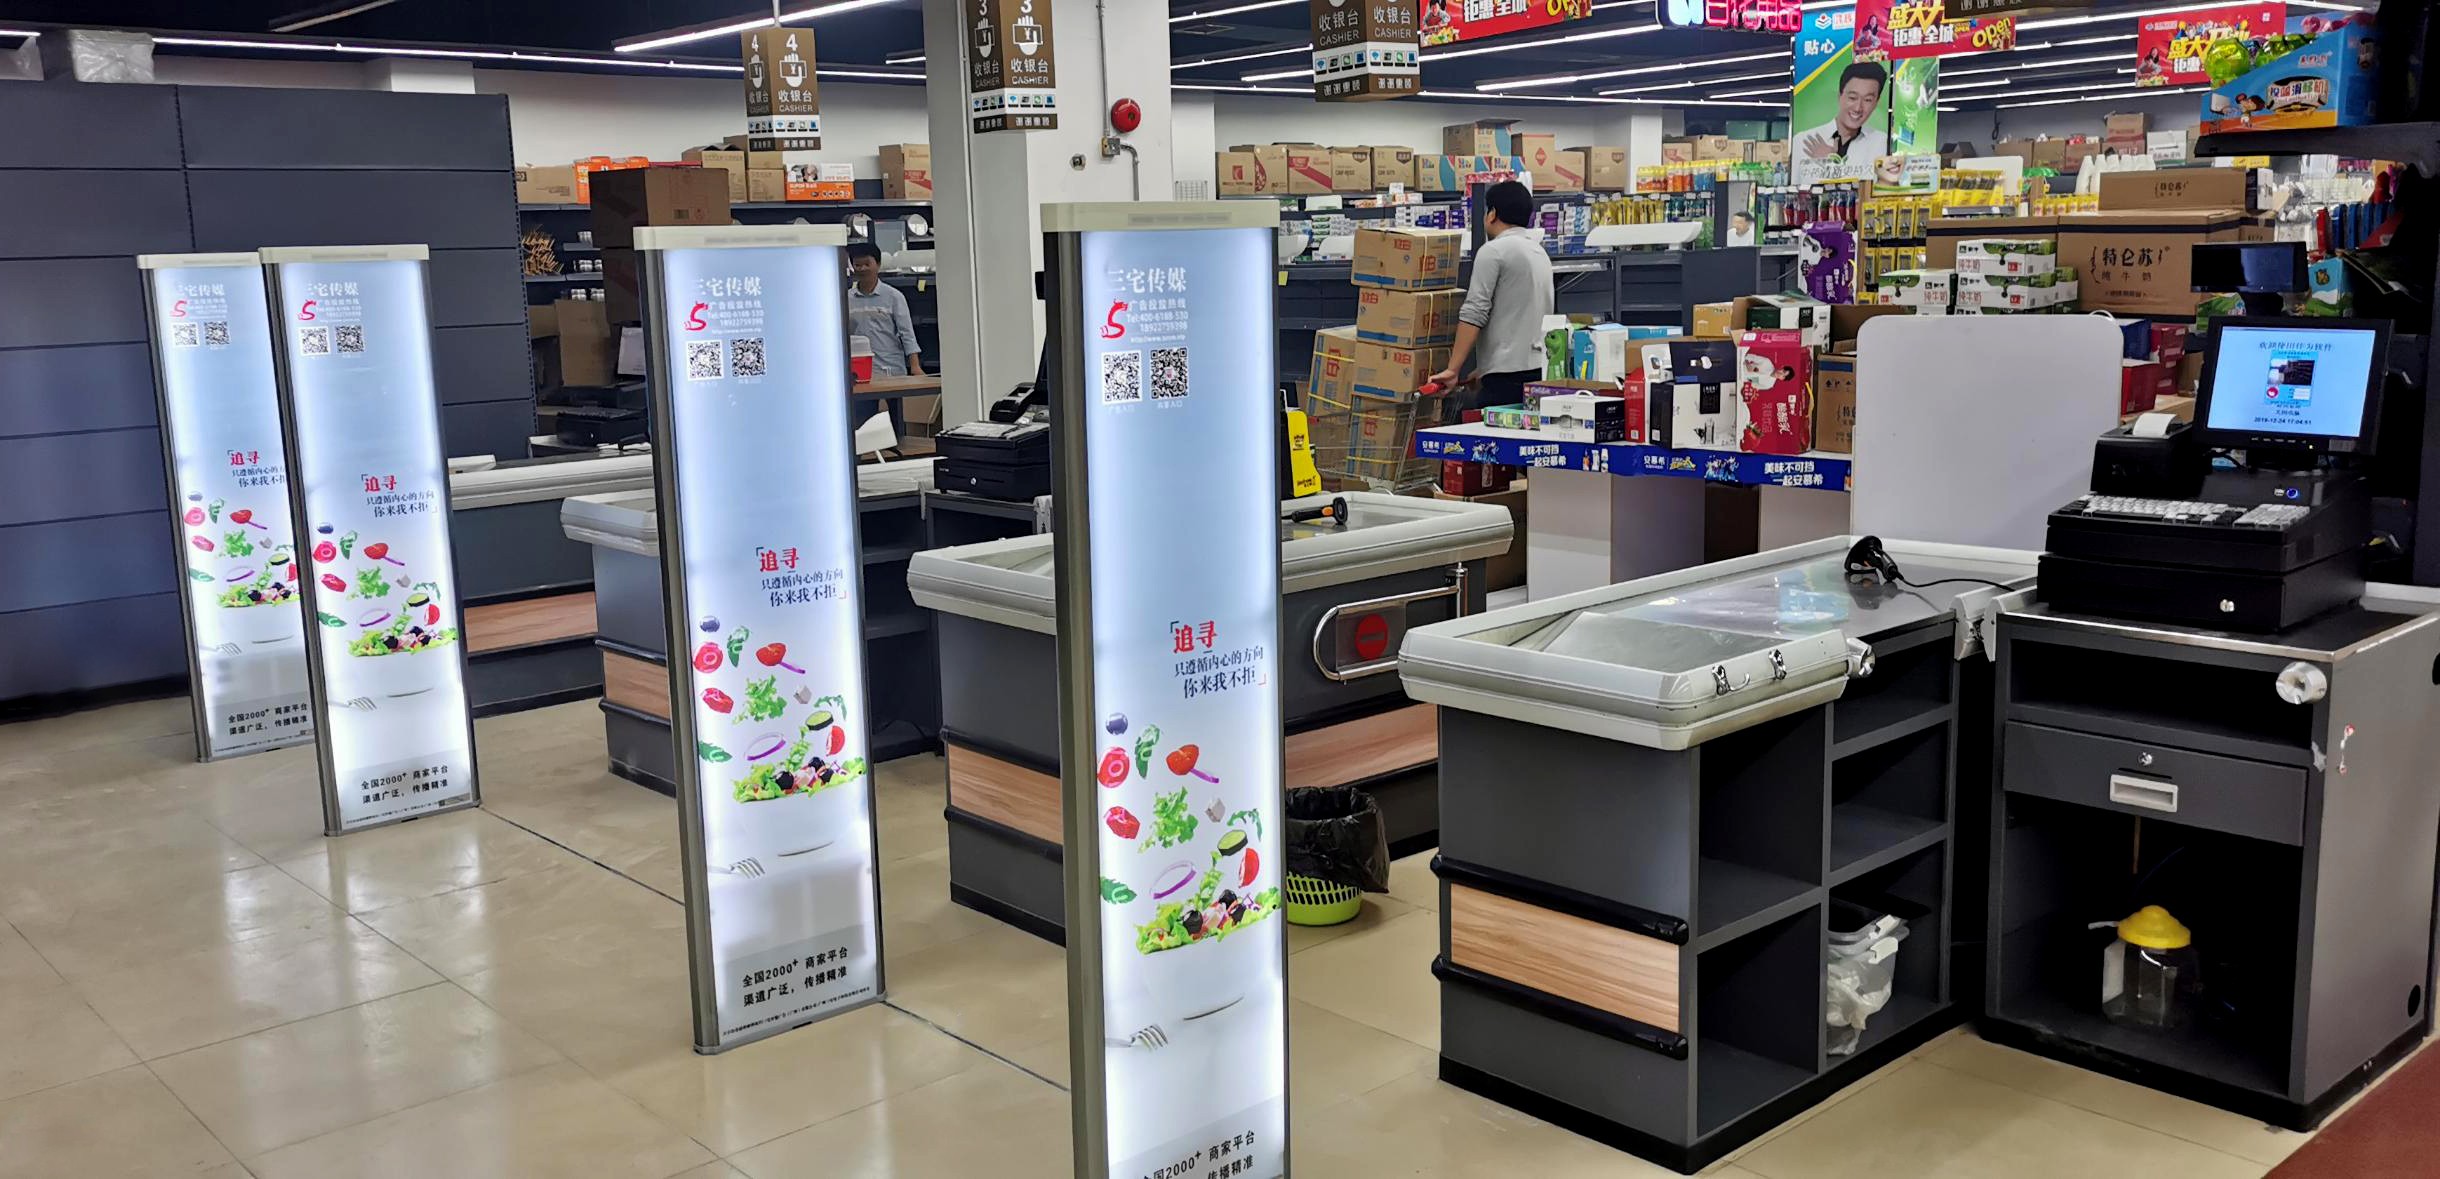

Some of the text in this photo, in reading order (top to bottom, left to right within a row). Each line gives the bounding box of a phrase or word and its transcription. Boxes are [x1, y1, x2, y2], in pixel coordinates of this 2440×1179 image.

[1318, 9, 1361, 33] 收银台
[1374, 6, 1415, 25] 收银台
[1319, 30, 1361, 48] CASHIER
[1375, 28, 1416, 40] CASHIER
[1893, 23, 1954, 47] 钜惠全城
[1972, 17, 2011, 47] open
[751, 33, 759, 52] 4
[785, 33, 798, 51] 4
[1804, 39, 1836, 57] 贴心
[974, 60, 1000, 77] 收银台
[1010, 58, 1049, 73] 收银台
[975, 77, 1001, 88] CASHIER
[1011, 76, 1049, 85] CASHIER
[778, 90, 813, 103] 收银台
[779, 105, 813, 113] CASHIER
[2101, 247, 2154, 267] 特仑苏
[699, 277, 762, 296] 三宅传媒
[1106, 267, 1187, 293] 三宅传媒
[230, 450, 260, 466] 追寻
[1764, 461, 1815, 474] 美味不可挡
[364, 474, 397, 492] 追寻
[1773, 473, 1824, 487] 一起安慕希
[759, 547, 799, 572] 追寻
[761, 568, 843, 591] 只遵循内心的方向
[770, 584, 837, 607] 你来我不拒
[1174, 620, 1217, 654] 追寻
[1174, 645, 1264, 677] 只遵循内心的方向
[1183, 665, 1256, 699] 你来我不拒
[274, 702, 308, 715] 商家平台
[274, 715, 308, 727] 传播精准
[412, 764, 448, 780] 商家平台
[412, 779, 448, 794] 传播精准
[805, 946, 848, 969] 商家平台
[804, 965, 848, 989] 传播精准
[1143, 1130, 1255, 1179] 国2000+ 商家平台
